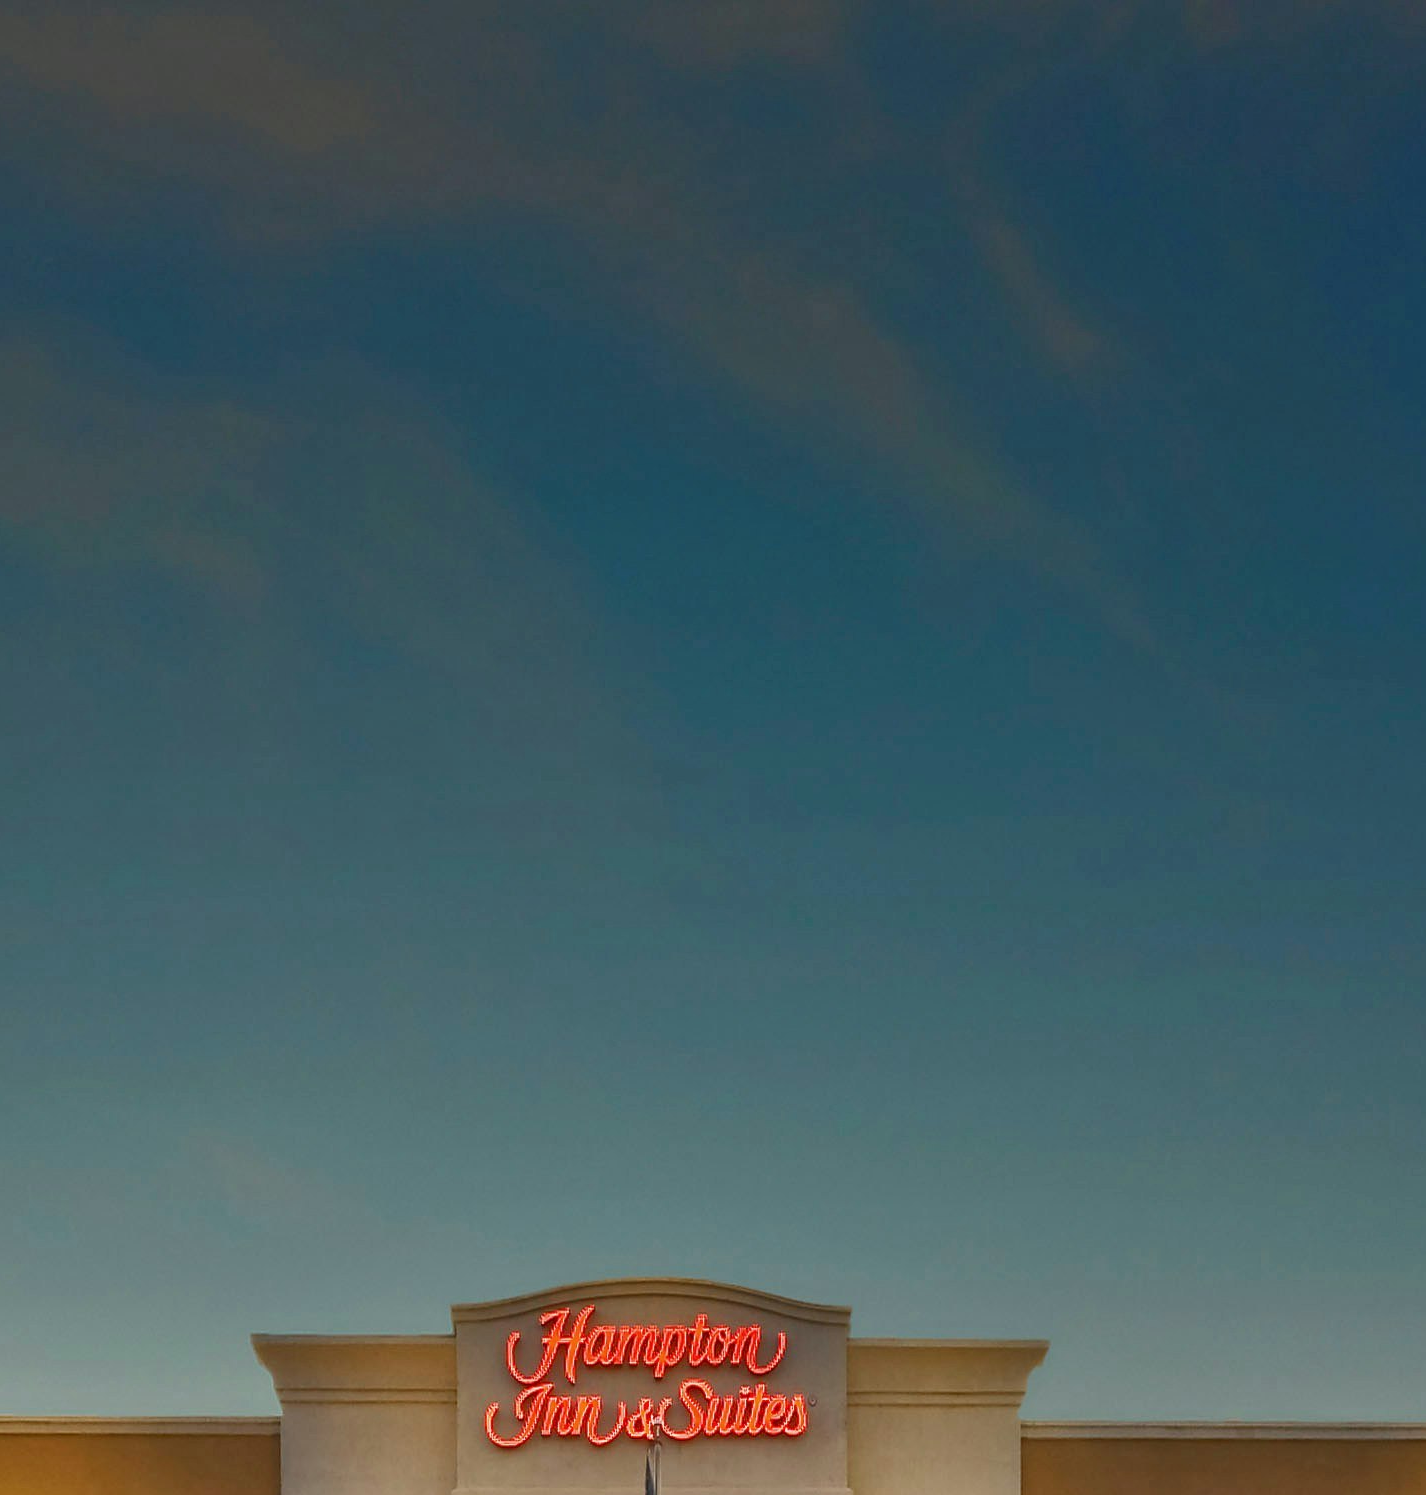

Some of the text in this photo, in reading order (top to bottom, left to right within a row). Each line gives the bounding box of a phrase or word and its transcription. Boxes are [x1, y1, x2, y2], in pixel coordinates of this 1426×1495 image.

[506, 1304, 787, 1386] Hampton
[485, 1378, 809, 1448] Inn & Suites
